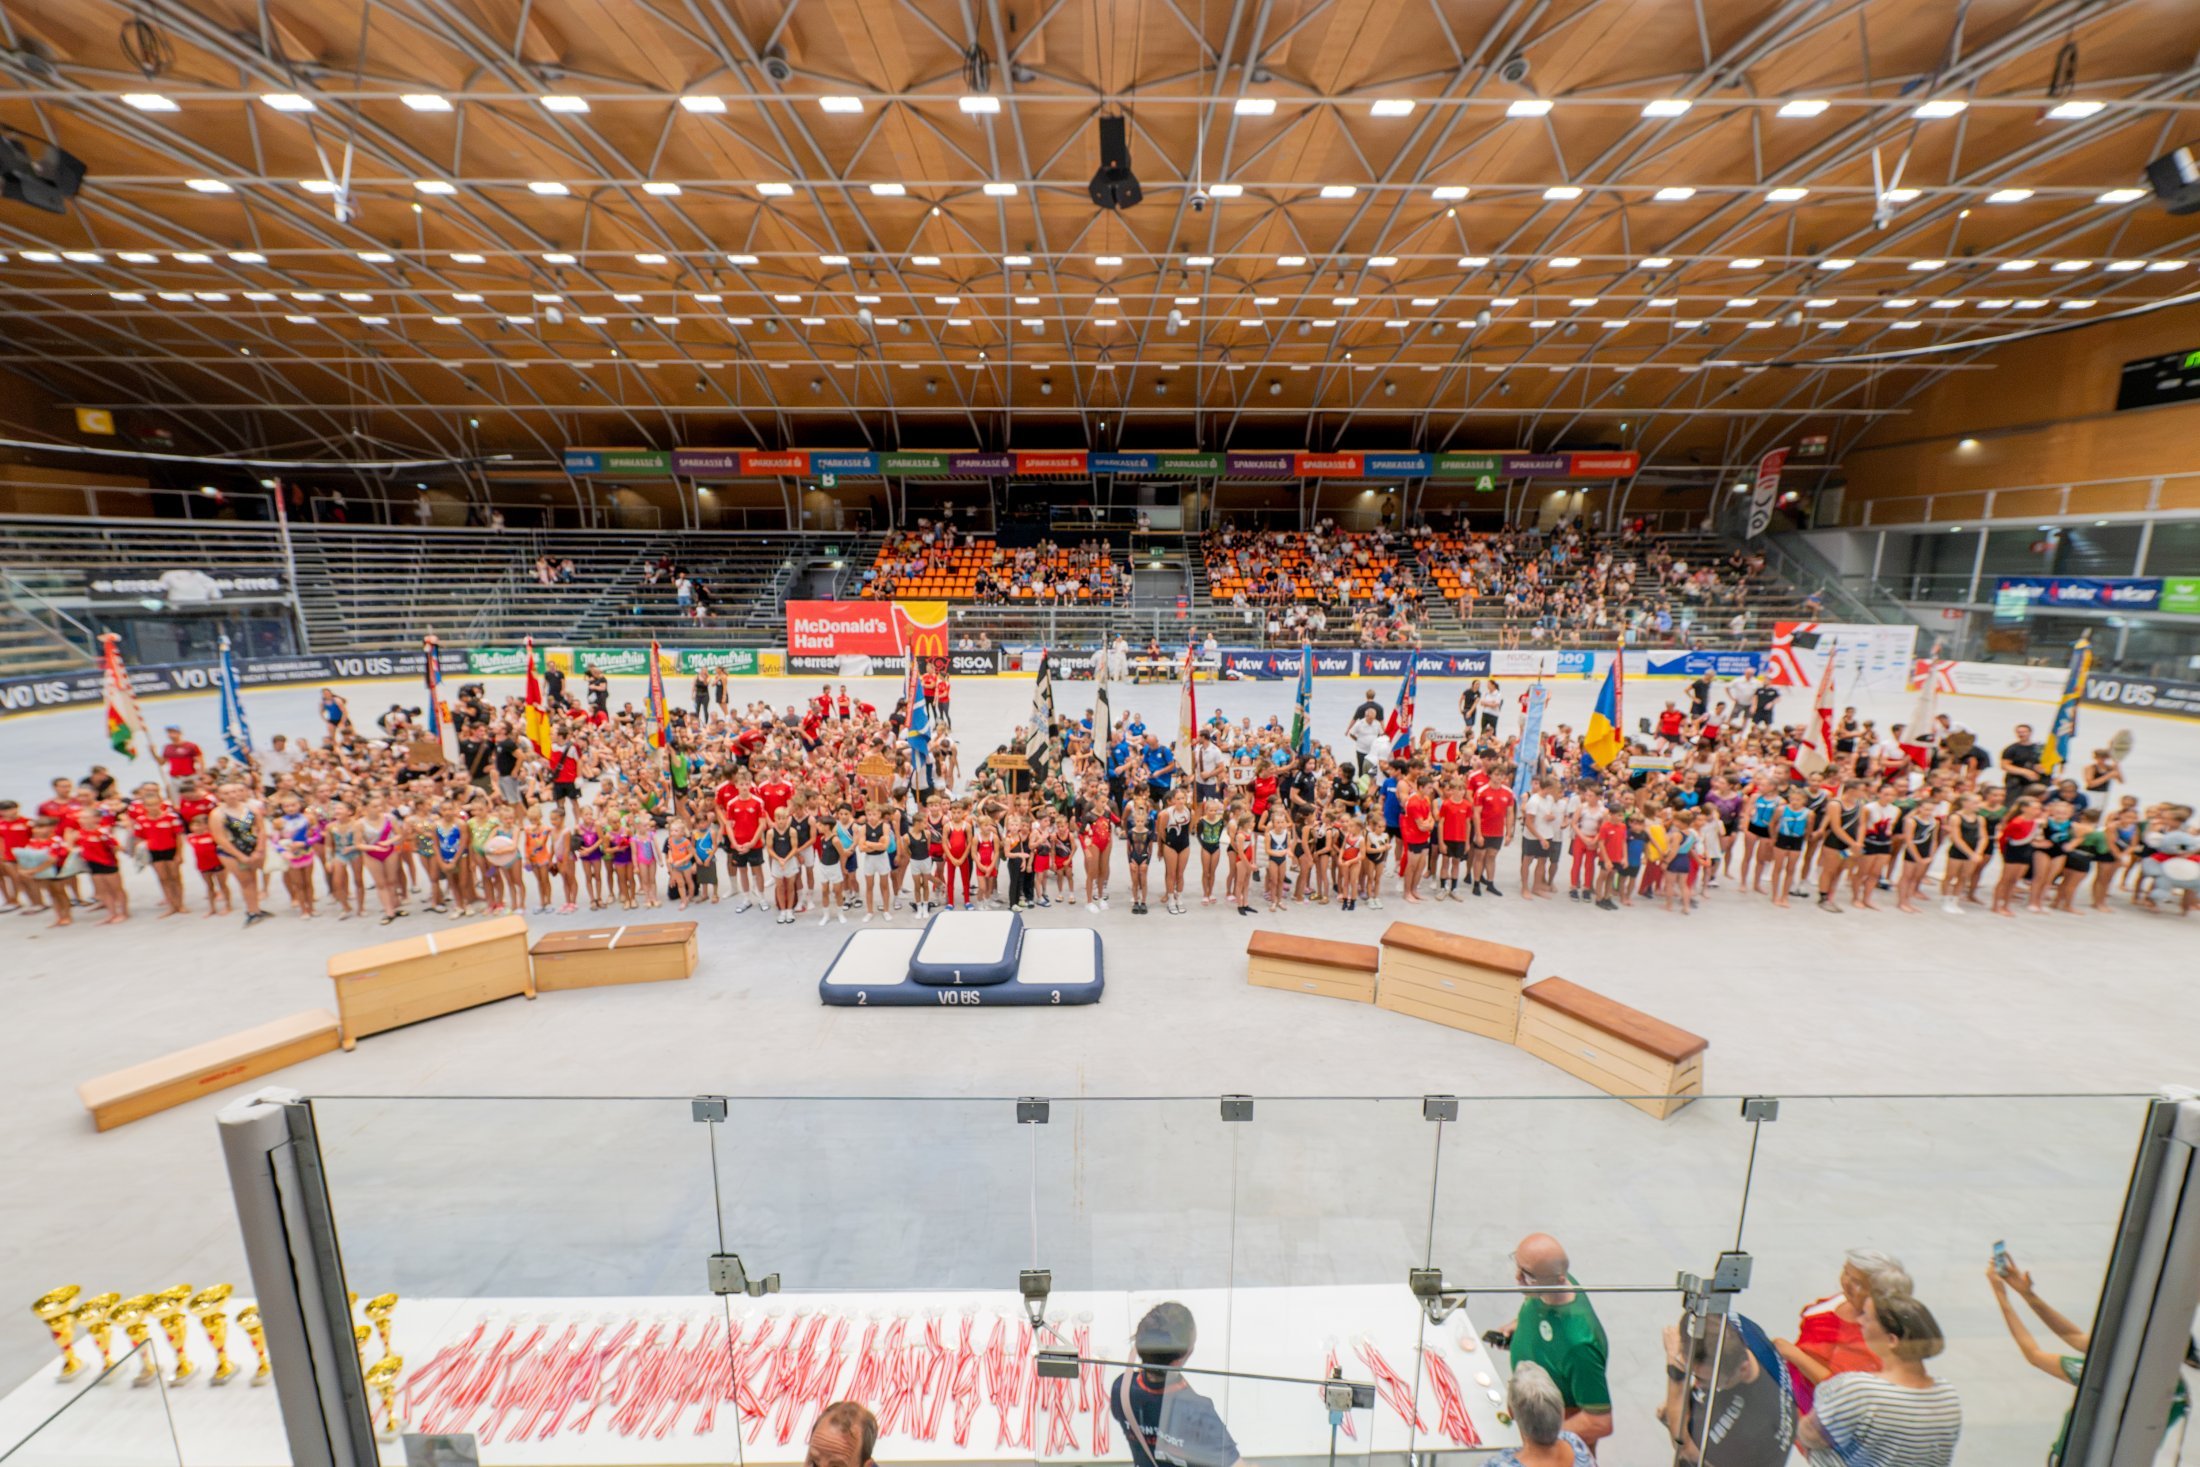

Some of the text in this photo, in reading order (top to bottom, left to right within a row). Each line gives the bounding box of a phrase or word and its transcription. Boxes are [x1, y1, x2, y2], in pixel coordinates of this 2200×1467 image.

[84, 412, 105, 430] C
[822, 474, 835, 486] B
[1478, 476, 1493, 490] A
[794, 618, 887, 634] McDonald's
[794, 634, 834, 648] Hard
[334, 659, 364, 676] VO
[1234, 659, 1263, 671] vkw
[1319, 659, 1348, 671] vkw
[1373, 659, 1401, 671] vkw
[1456, 659, 1486, 672] vkw
[171, 669, 209, 690] VO
[2086, 679, 2120, 702] VO
[953, 970, 963, 984] 1
[857, 991, 867, 1005] 2
[938, 990, 958, 1004] VO
[1051, 990, 1060, 1004] 3
